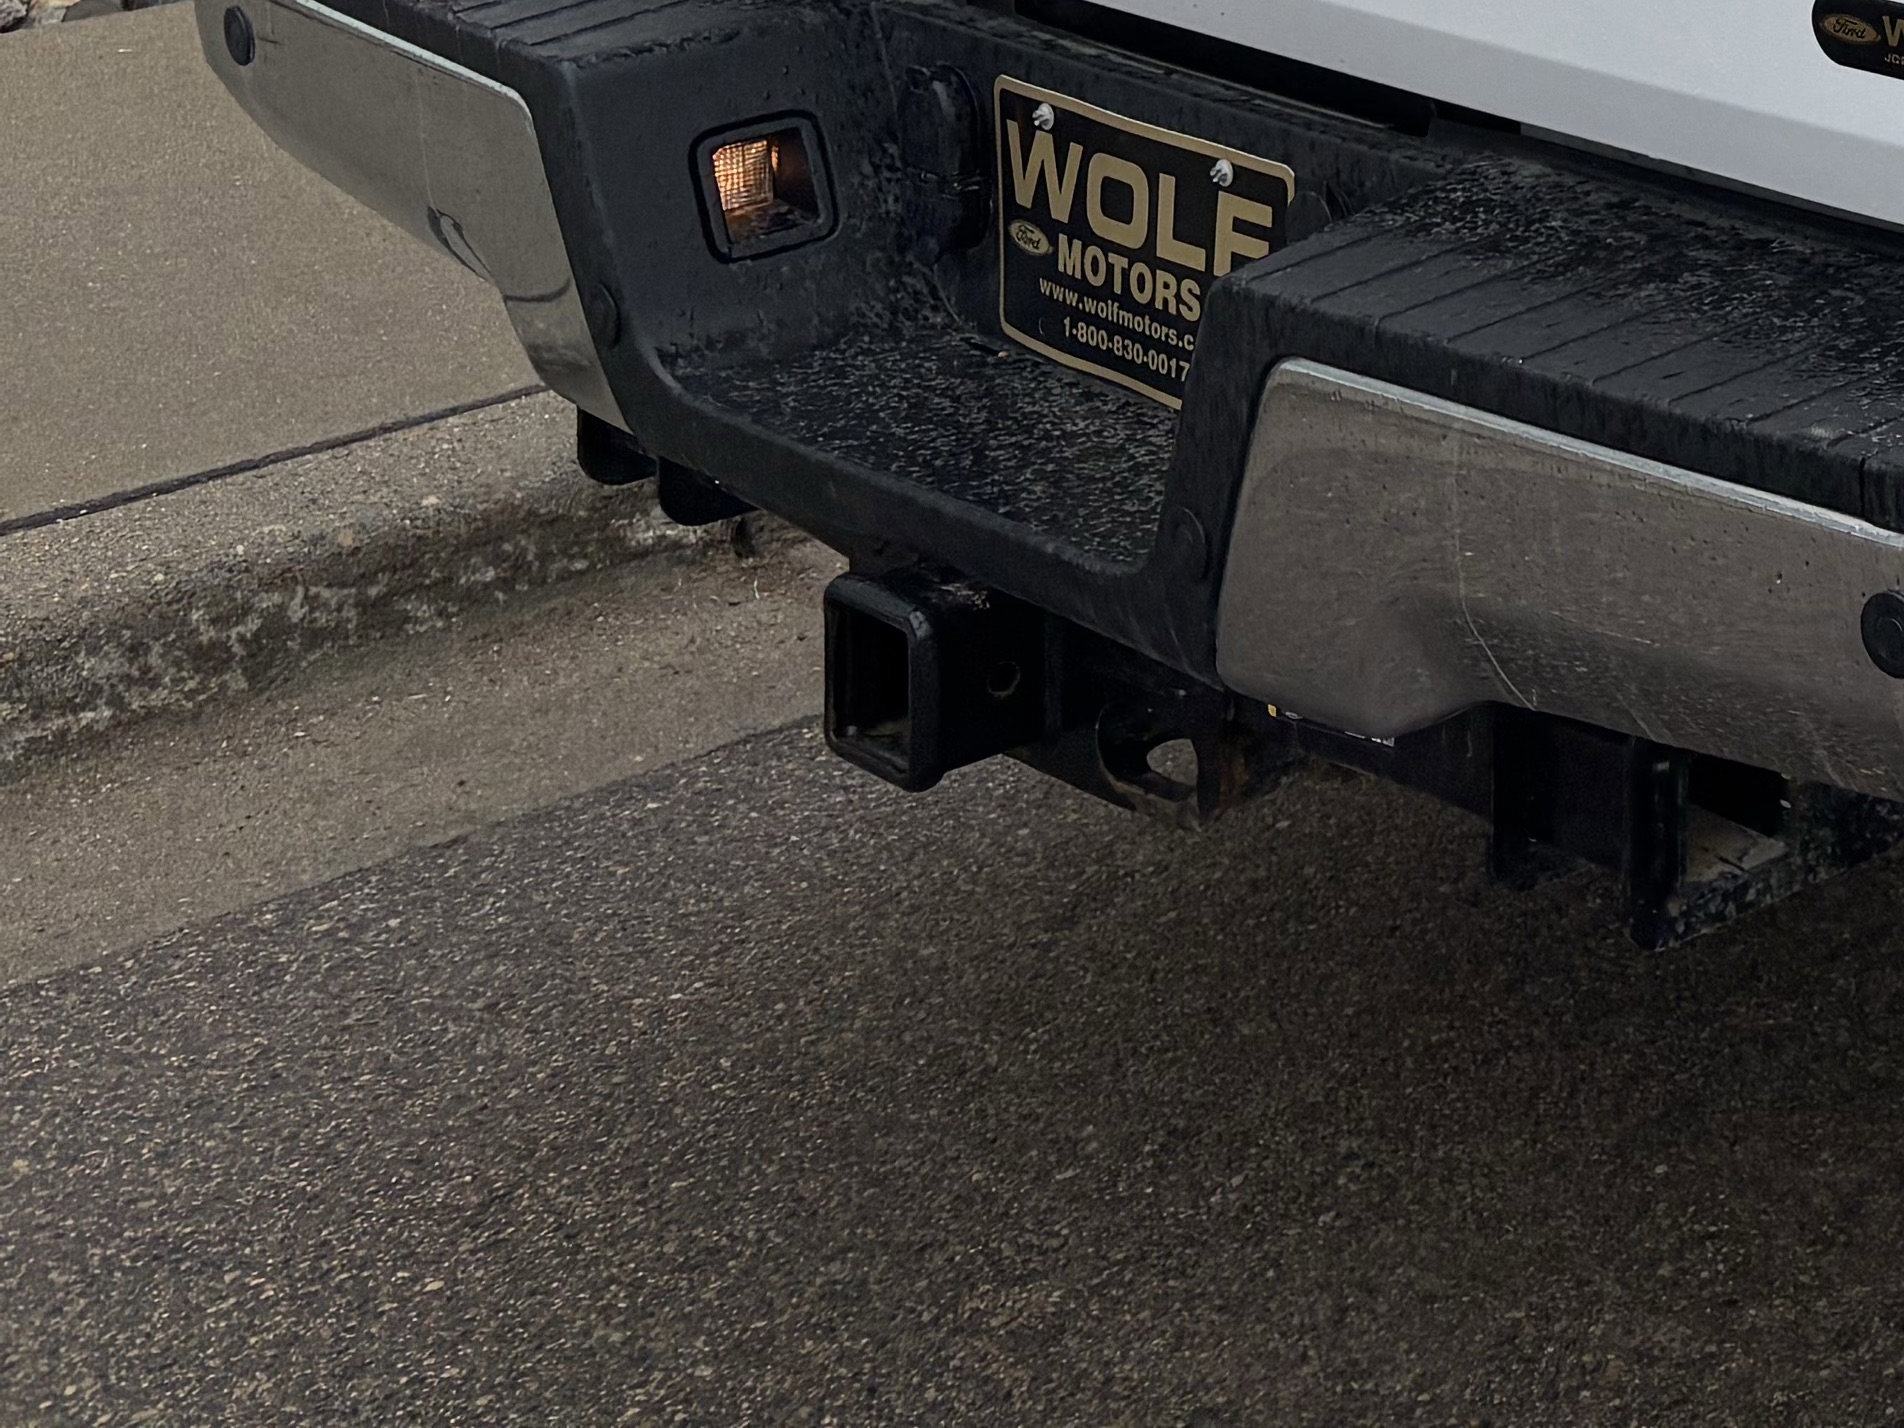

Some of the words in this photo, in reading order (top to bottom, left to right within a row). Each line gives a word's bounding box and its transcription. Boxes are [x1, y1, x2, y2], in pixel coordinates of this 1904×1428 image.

[1007, 119, 1273, 277] WOLF
[1040, 277, 1195, 351] www.wolfmotors.c
[1058, 234, 1201, 322] MOTORS
